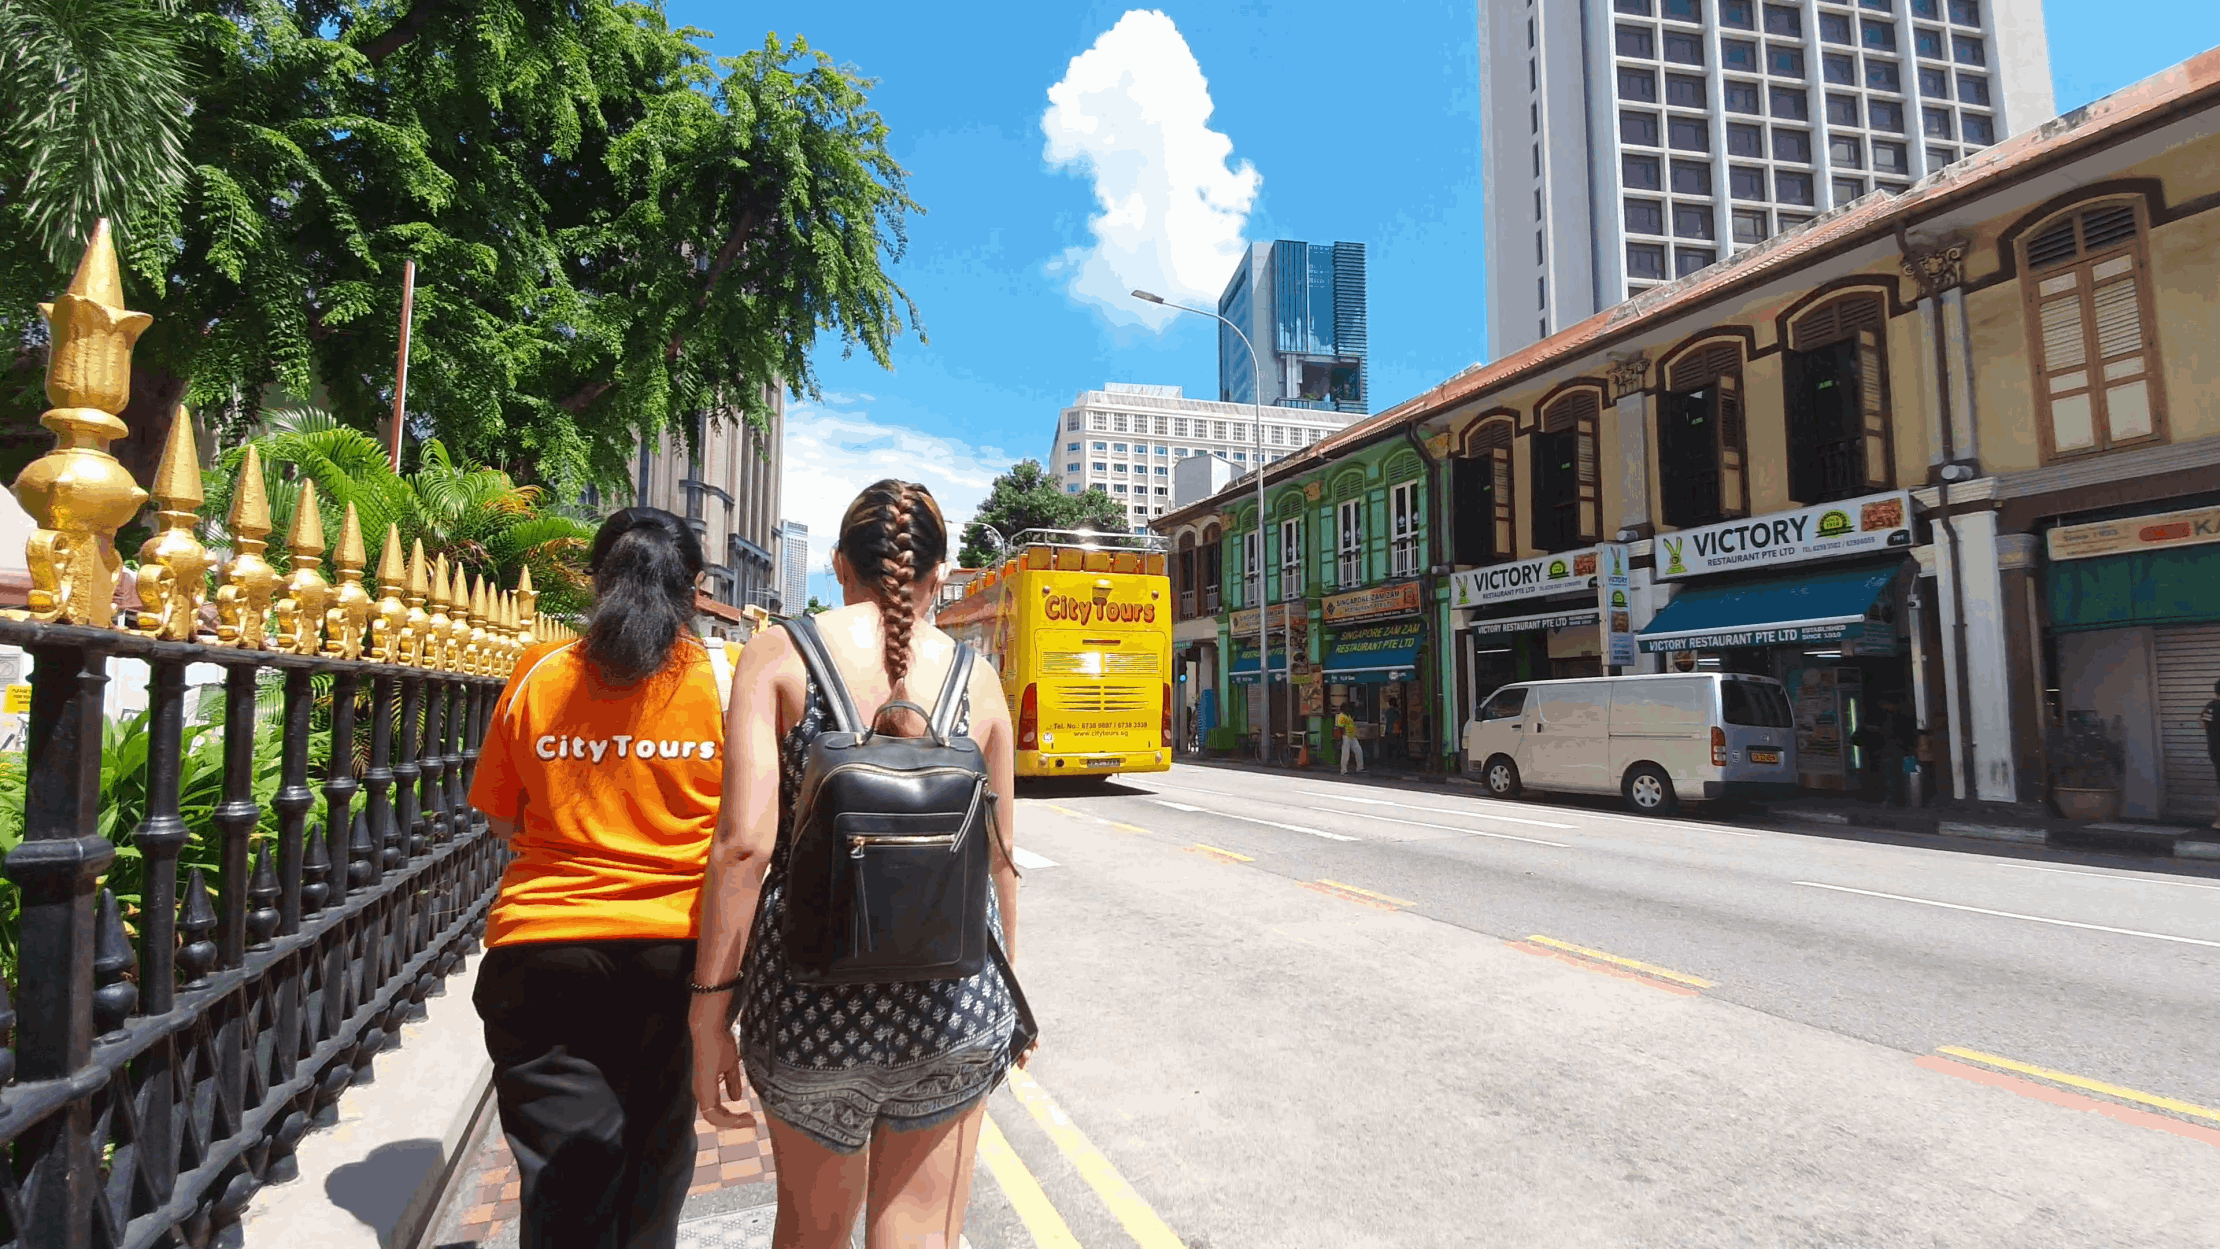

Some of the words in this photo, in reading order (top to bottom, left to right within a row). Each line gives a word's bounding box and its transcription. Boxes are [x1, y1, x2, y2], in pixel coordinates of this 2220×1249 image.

[1693, 515, 1809, 557] VICTORY
[1707, 552, 1760, 566] RESTAURANT
[1761, 549, 1778, 560] PTE
[1779, 546, 1795, 557] LTD
[1474, 562, 1543, 592] VICTORY
[1607, 575, 1628, 583] VICTORY
[1336, 595, 1370, 607] SINGAPORE
[1371, 593, 1385, 601] ZAM
[1386, 590, 1400, 599] ZAM
[1482, 590, 1514, 599] RESTAURANT
[1525, 586, 1535, 594] LTD
[1340, 627, 1384, 641] SINGAPORE
[1383, 626, 1401, 637] ZAM
[1401, 623, 1421, 635] ZAM
[1478, 624, 1502, 634] VICTORY
[1502, 620, 1541, 632] RESTAURANT
[1542, 618, 1555, 628] PTE
[1555, 616, 1567, 626] LTD
[1335, 640, 1384, 654] RESTAURANT
[1383, 639, 1398, 650] PTE
[1398, 637, 1415, 648] LTD
[1649, 639, 1687, 652] VICTORY
[1689, 633, 1752, 649] RESTAURANT
[1755, 631, 1776, 643] PTE
[1778, 628, 1798, 641] LTD
